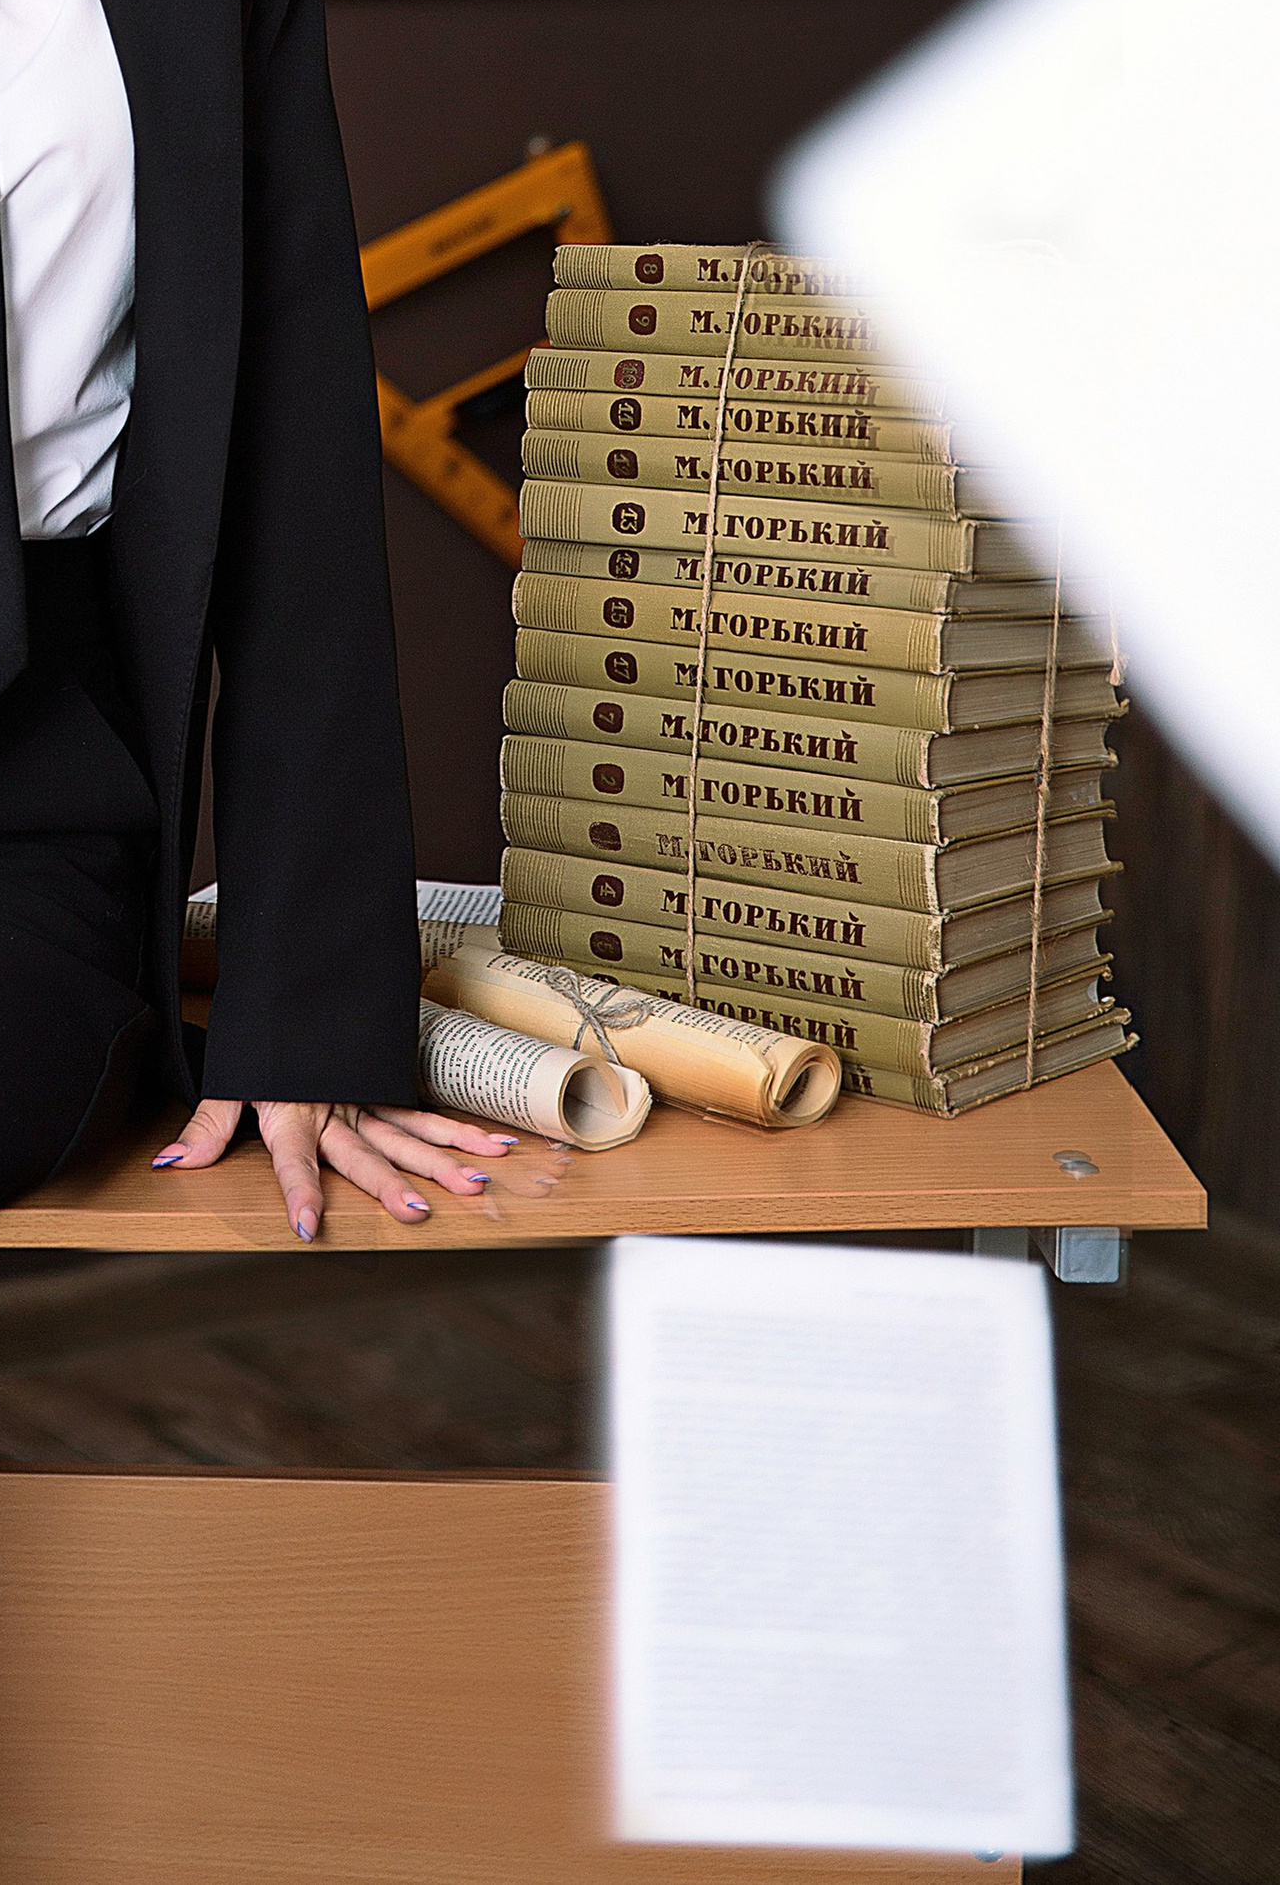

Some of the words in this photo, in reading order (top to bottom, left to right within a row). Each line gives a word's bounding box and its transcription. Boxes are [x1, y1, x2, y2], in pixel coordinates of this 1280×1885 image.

[642, 263, 658, 275] 8
[726, 308, 872, 340] ГОРЬКИЙ
[713, 367, 871, 396] ГОРЬКИЙ
[618, 402, 635, 426] 11
[715, 408, 872, 440] ГОРЬКИЙ
[717, 459, 875, 490] ГОРЬКИЙ
[620, 506, 638, 531] 13
[722, 515, 890, 549] ГОРЬКИЙ
[711, 561, 873, 596] ГОРЬКИЙ
[611, 601, 628, 624] 15
[706, 611, 868, 652] ГОРЬКИЙ
[613, 656, 630, 680] 17
[713, 666, 876, 707] ГОРЬКИЙ
[599, 712, 615, 724] 7
[696, 719, 858, 764] ГОРЬКИЙ
[700, 778, 864, 823] ГОРЬКИЙ
[695, 839, 862, 885] ГОРЬКИЙ
[599, 881, 616, 898] 4
[701, 896, 867, 948] ГОРЬКИЙ
[699, 952, 866, 1002] ГОРЬКИЙ
